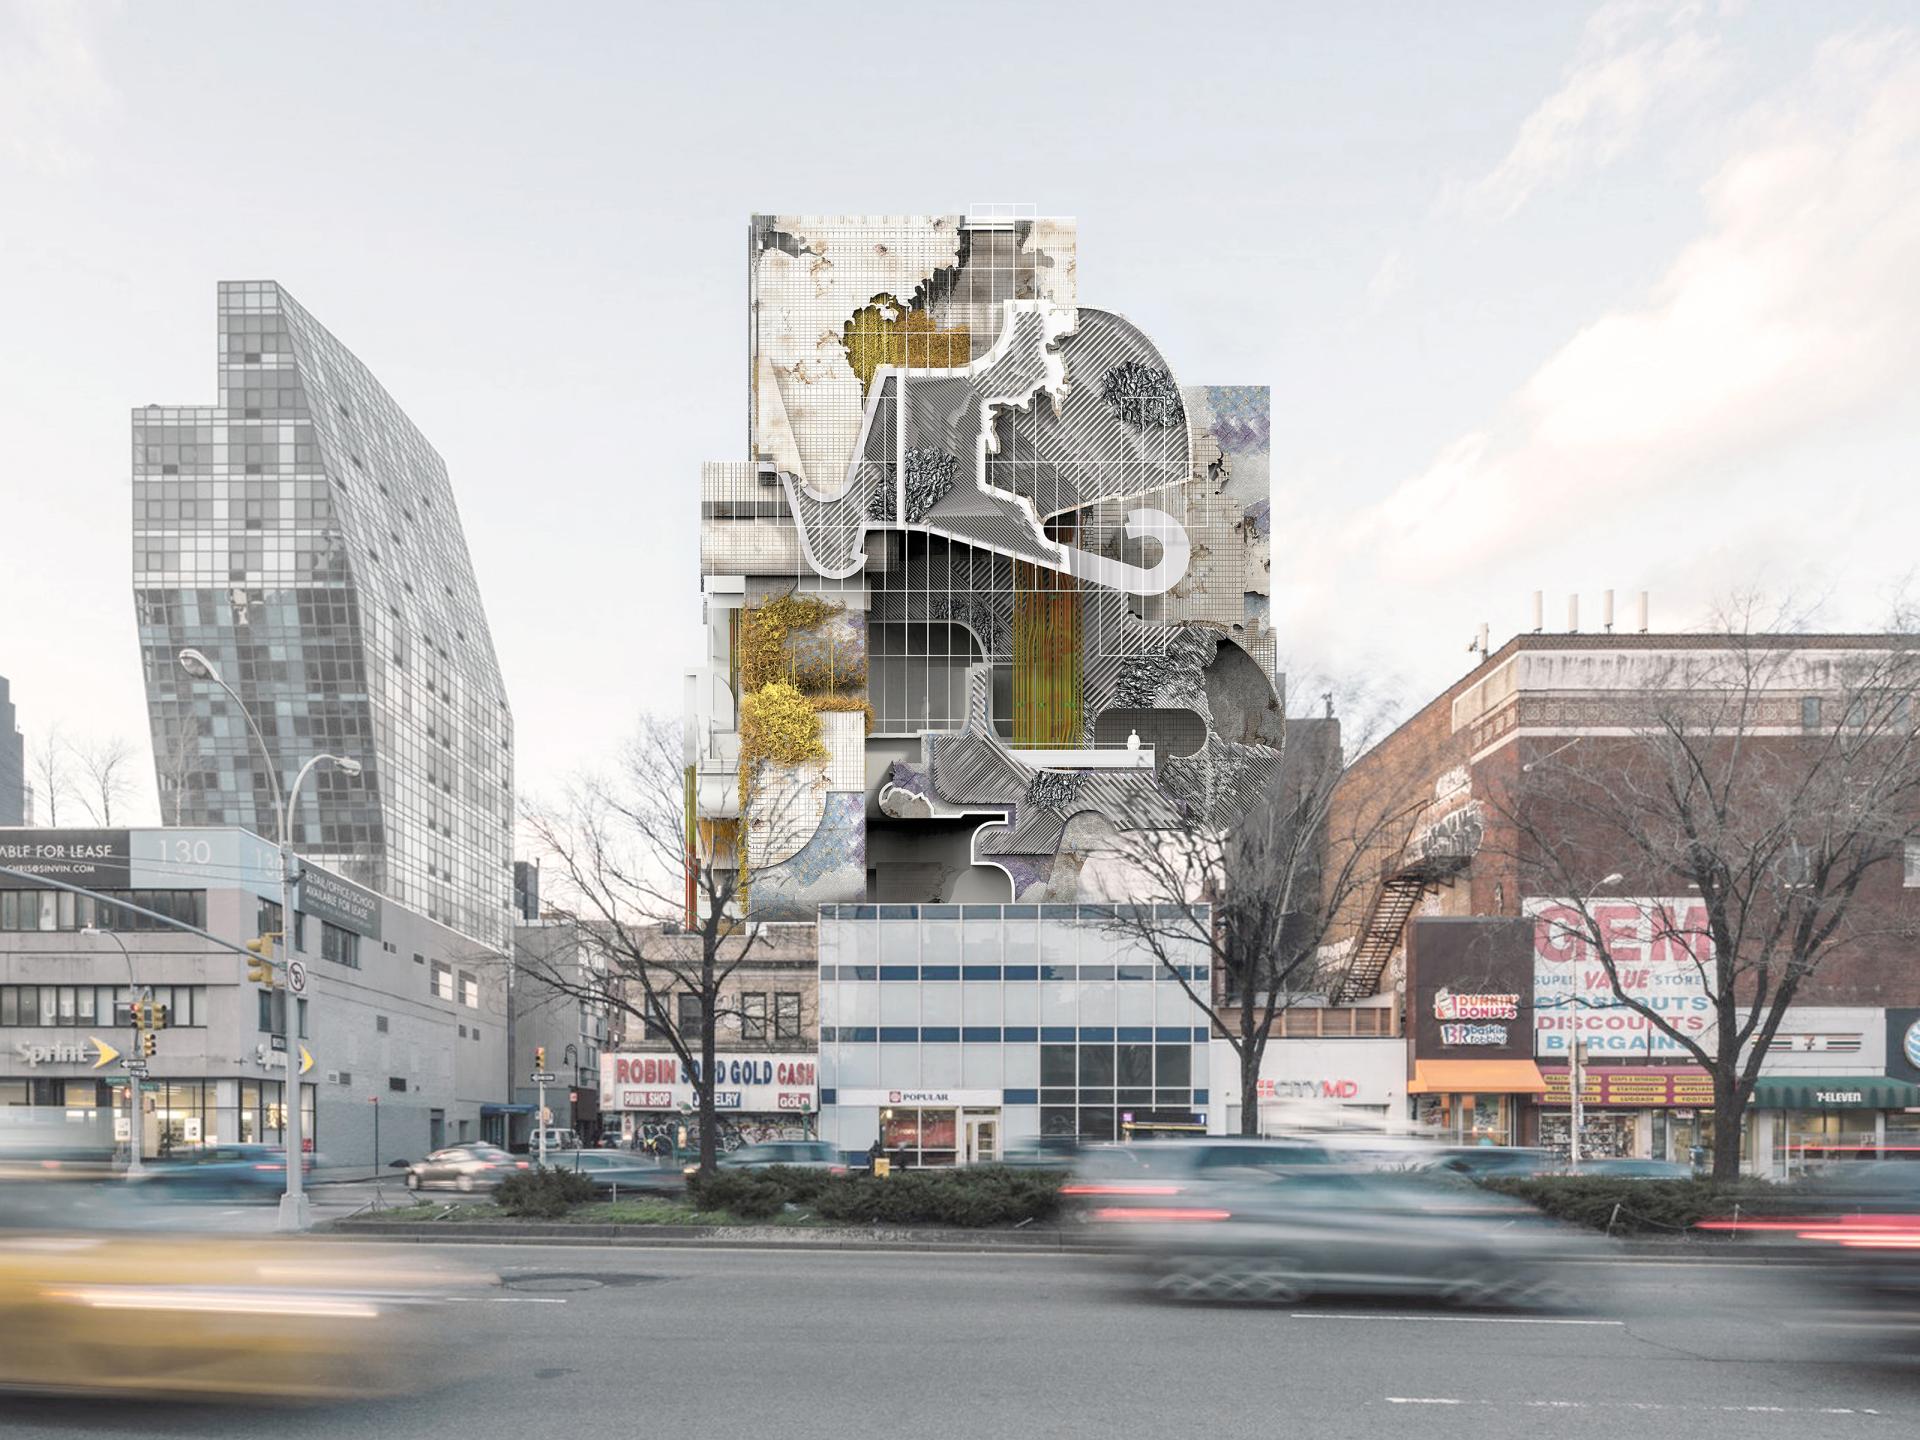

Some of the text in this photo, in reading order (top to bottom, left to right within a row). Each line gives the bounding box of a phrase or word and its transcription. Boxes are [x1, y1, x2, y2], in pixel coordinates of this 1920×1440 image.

[36, 845, 65, 858] FOR
[70, 845, 112, 858] LEASE
[160, 839, 211, 864] 130
[1535, 905, 1711, 963] GEM
[1584, 970, 1650, 990] VAUE
[1459, 1007, 1516, 1018] DONUTS
[16, 1041, 87, 1067] Sprint
[617, 1059, 676, 1084] ROBIN
[730, 1060, 773, 1085] GOLD
[777, 1063, 815, 1085] CASH
[649, 1093, 670, 1105] SHOP
[780, 1096, 809, 1107] GOLD
